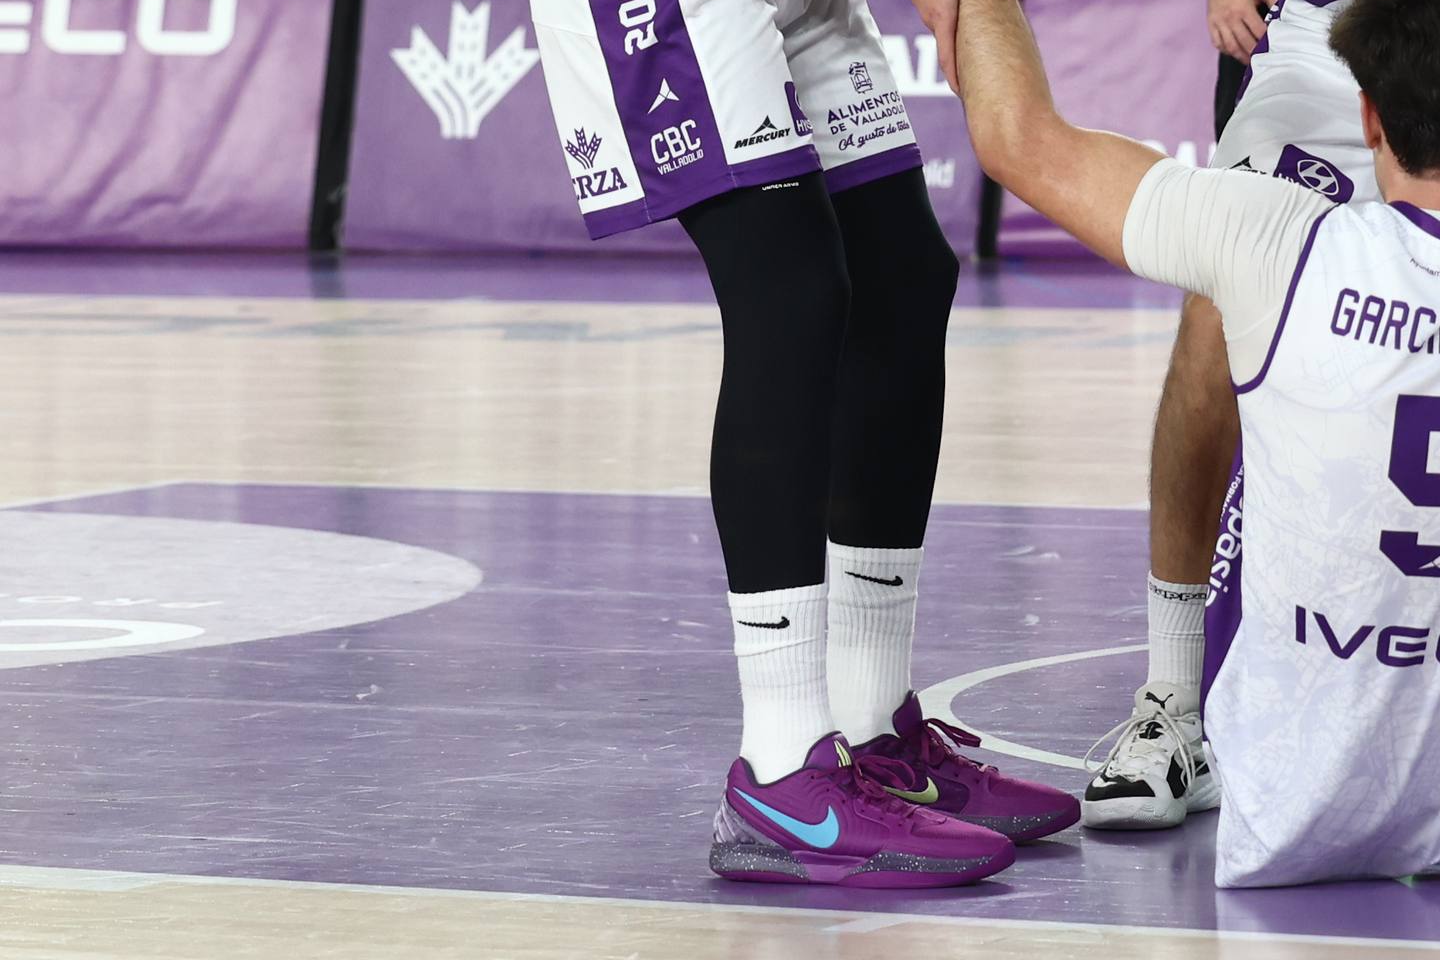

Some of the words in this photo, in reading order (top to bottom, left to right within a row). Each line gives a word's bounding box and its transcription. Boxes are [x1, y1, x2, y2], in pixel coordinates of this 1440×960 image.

[734, 127, 791, 149] MERCURY
[830, 123, 847, 135] DE
[857, 126, 884, 148] gusto
[886, 124, 896, 135] de
[650, 119, 701, 164] CBC
[657, 149, 704, 176] VALLADOLID
